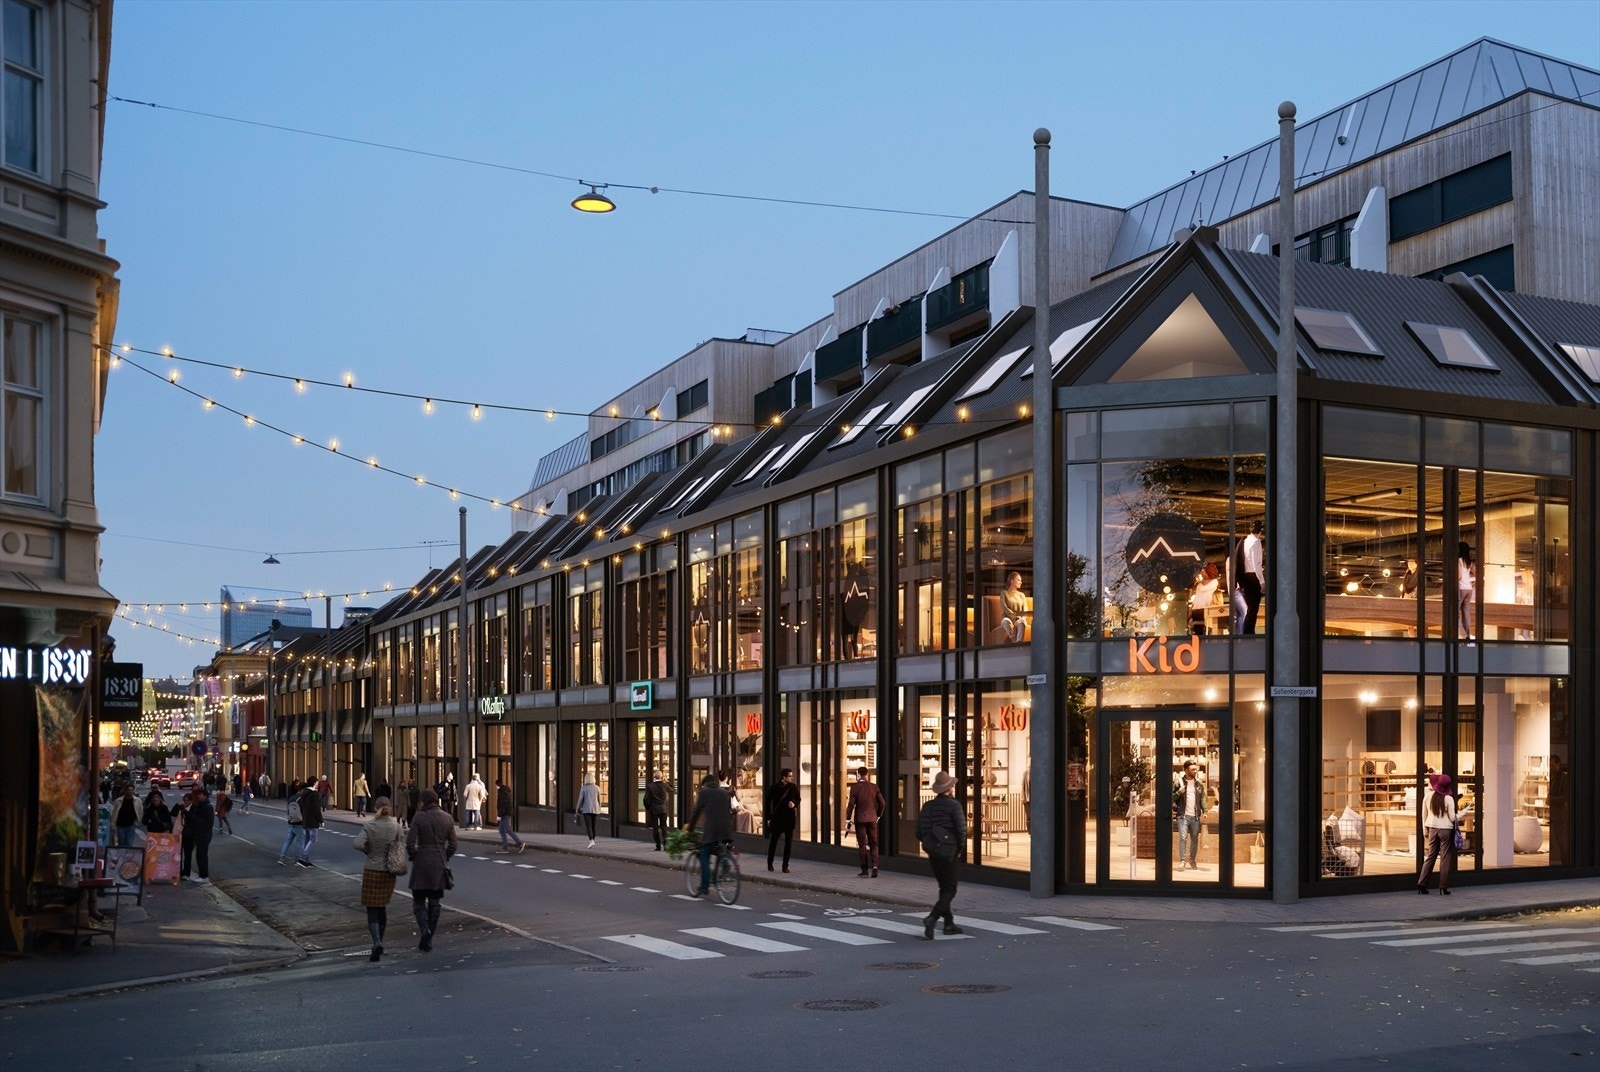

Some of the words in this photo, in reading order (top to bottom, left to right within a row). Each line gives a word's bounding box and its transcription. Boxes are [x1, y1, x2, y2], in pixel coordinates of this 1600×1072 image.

[1129, 634, 1200, 673] Kid
[745, 713, 762, 734] Kid
[849, 709, 871, 733] Kid
[998, 704, 1027, 731] Kid
